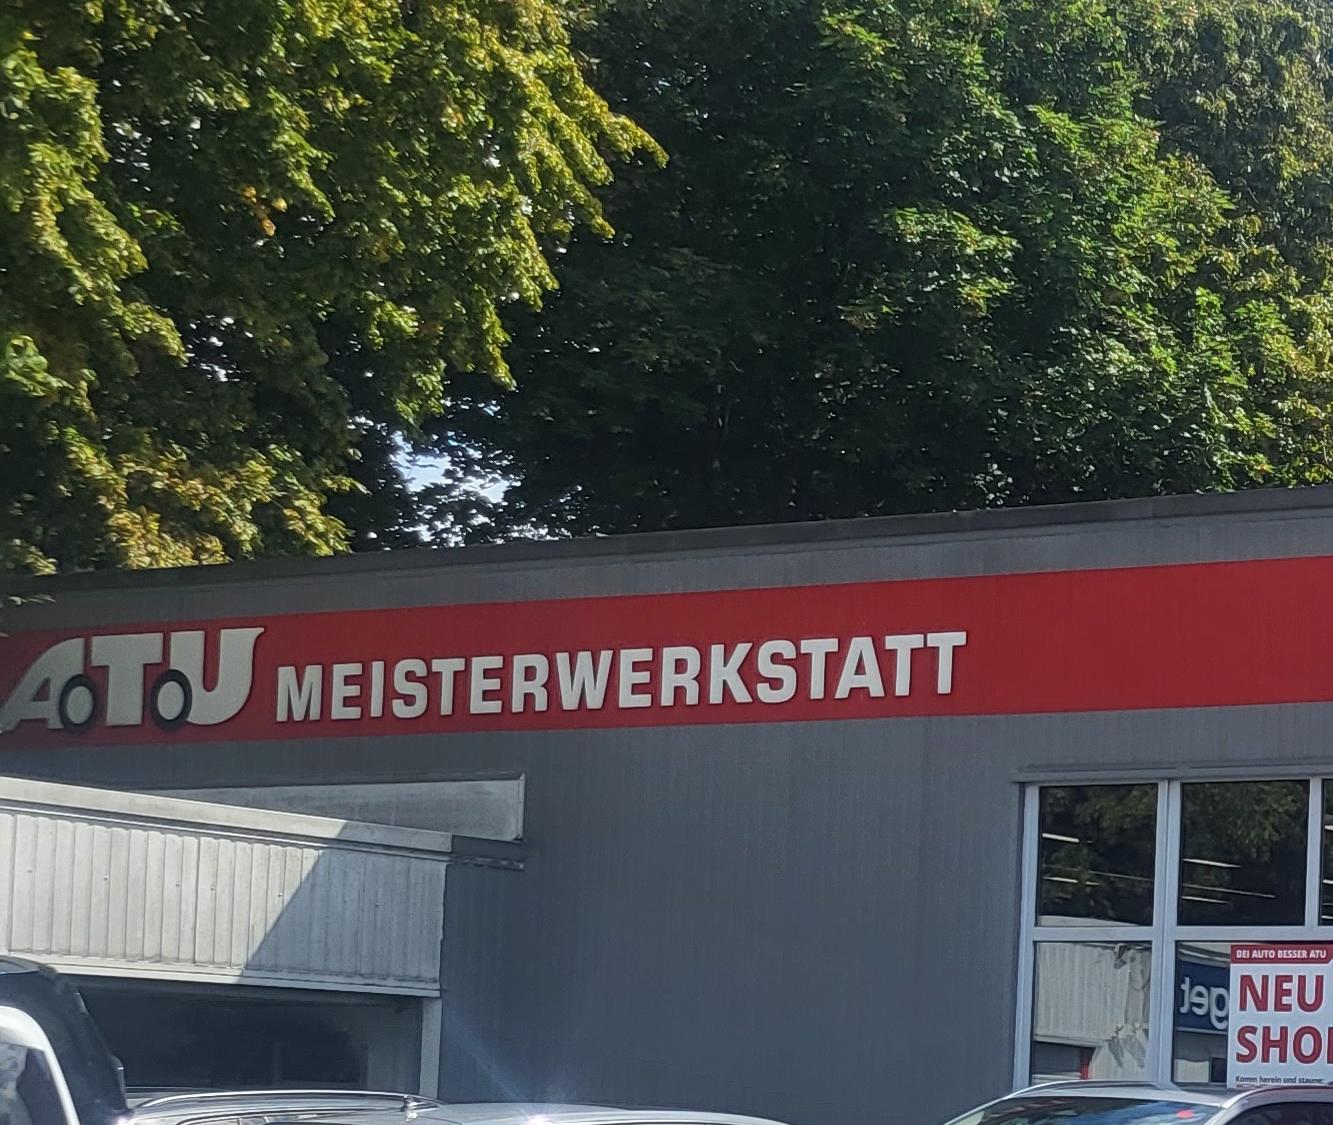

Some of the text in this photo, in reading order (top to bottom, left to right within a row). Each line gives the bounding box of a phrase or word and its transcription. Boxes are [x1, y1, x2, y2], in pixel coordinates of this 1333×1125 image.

[2, 626, 969, 734] ATU MEISTERWERKSTATT
[1236, 949, 1327, 959] BEI AUTO BESSER ATU
[1239, 974, 1325, 1012] NEU
[1283, 1076, 1297, 1084] und
